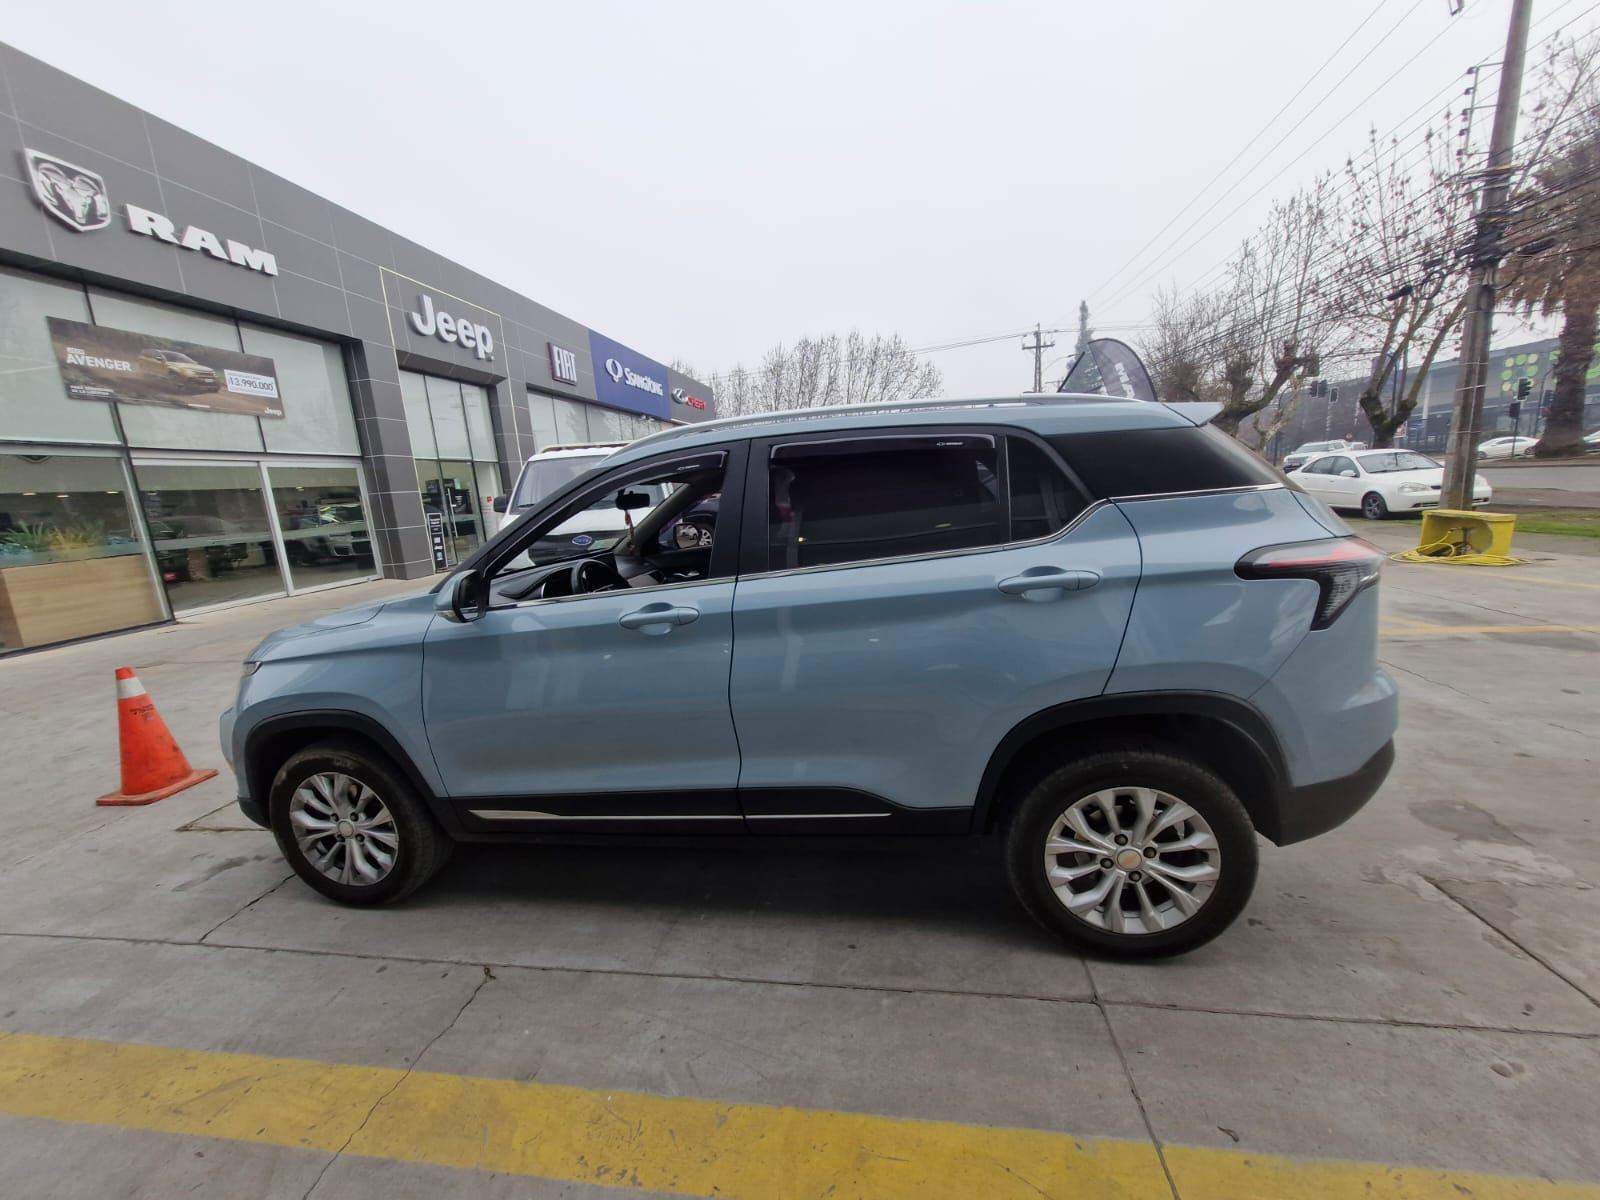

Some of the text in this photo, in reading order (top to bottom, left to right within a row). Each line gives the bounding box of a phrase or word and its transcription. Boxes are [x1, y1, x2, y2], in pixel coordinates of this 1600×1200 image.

[126, 203, 279, 276] RAM
[411, 294, 494, 359] Jeep
[66, 353, 132, 371] AVENGER
[552, 344, 577, 382] FIAT
